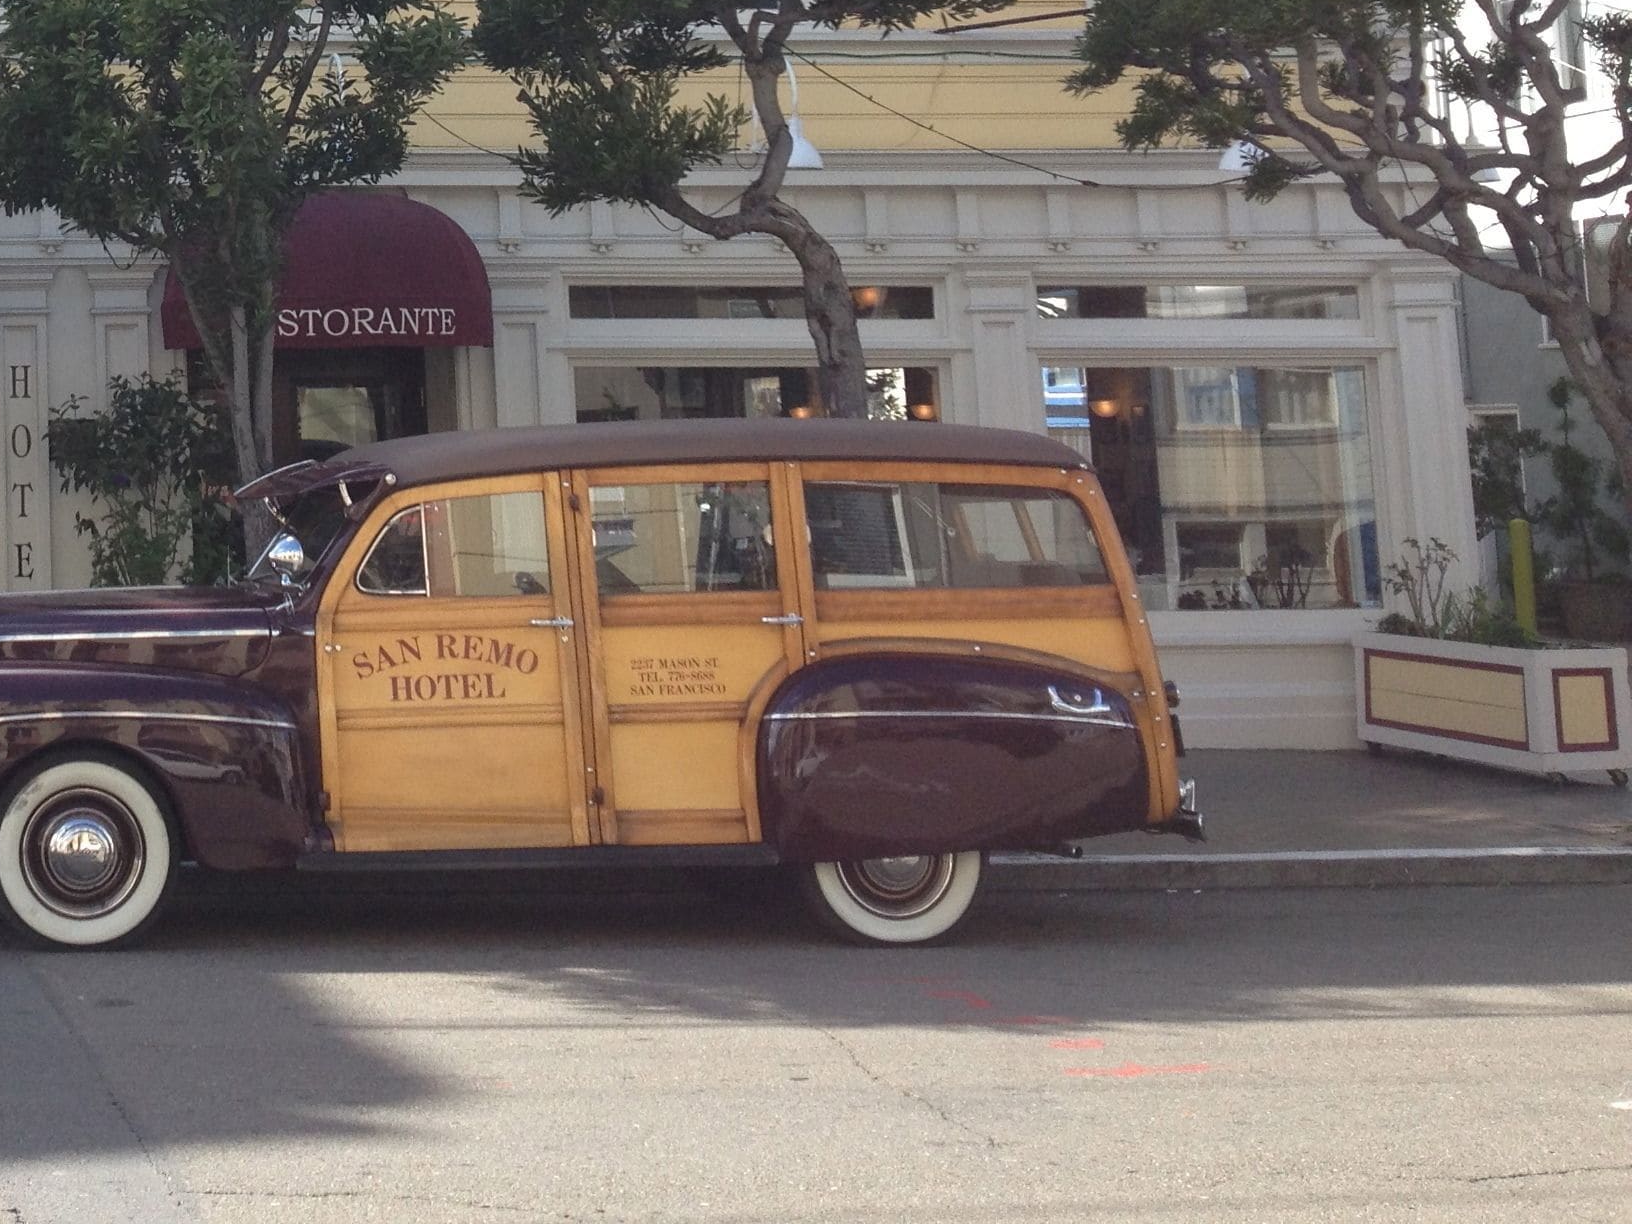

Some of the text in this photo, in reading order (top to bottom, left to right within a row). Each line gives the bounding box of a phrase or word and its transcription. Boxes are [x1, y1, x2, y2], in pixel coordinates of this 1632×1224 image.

[277, 307, 457, 337] STORANTE
[9, 364, 35, 581] HOTE
[352, 633, 539, 680] SAN REMO
[658, 656, 700, 670] MASON
[389, 673, 507, 702] HOTEL
[630, 683, 727, 696] SAN FRANCISCO
